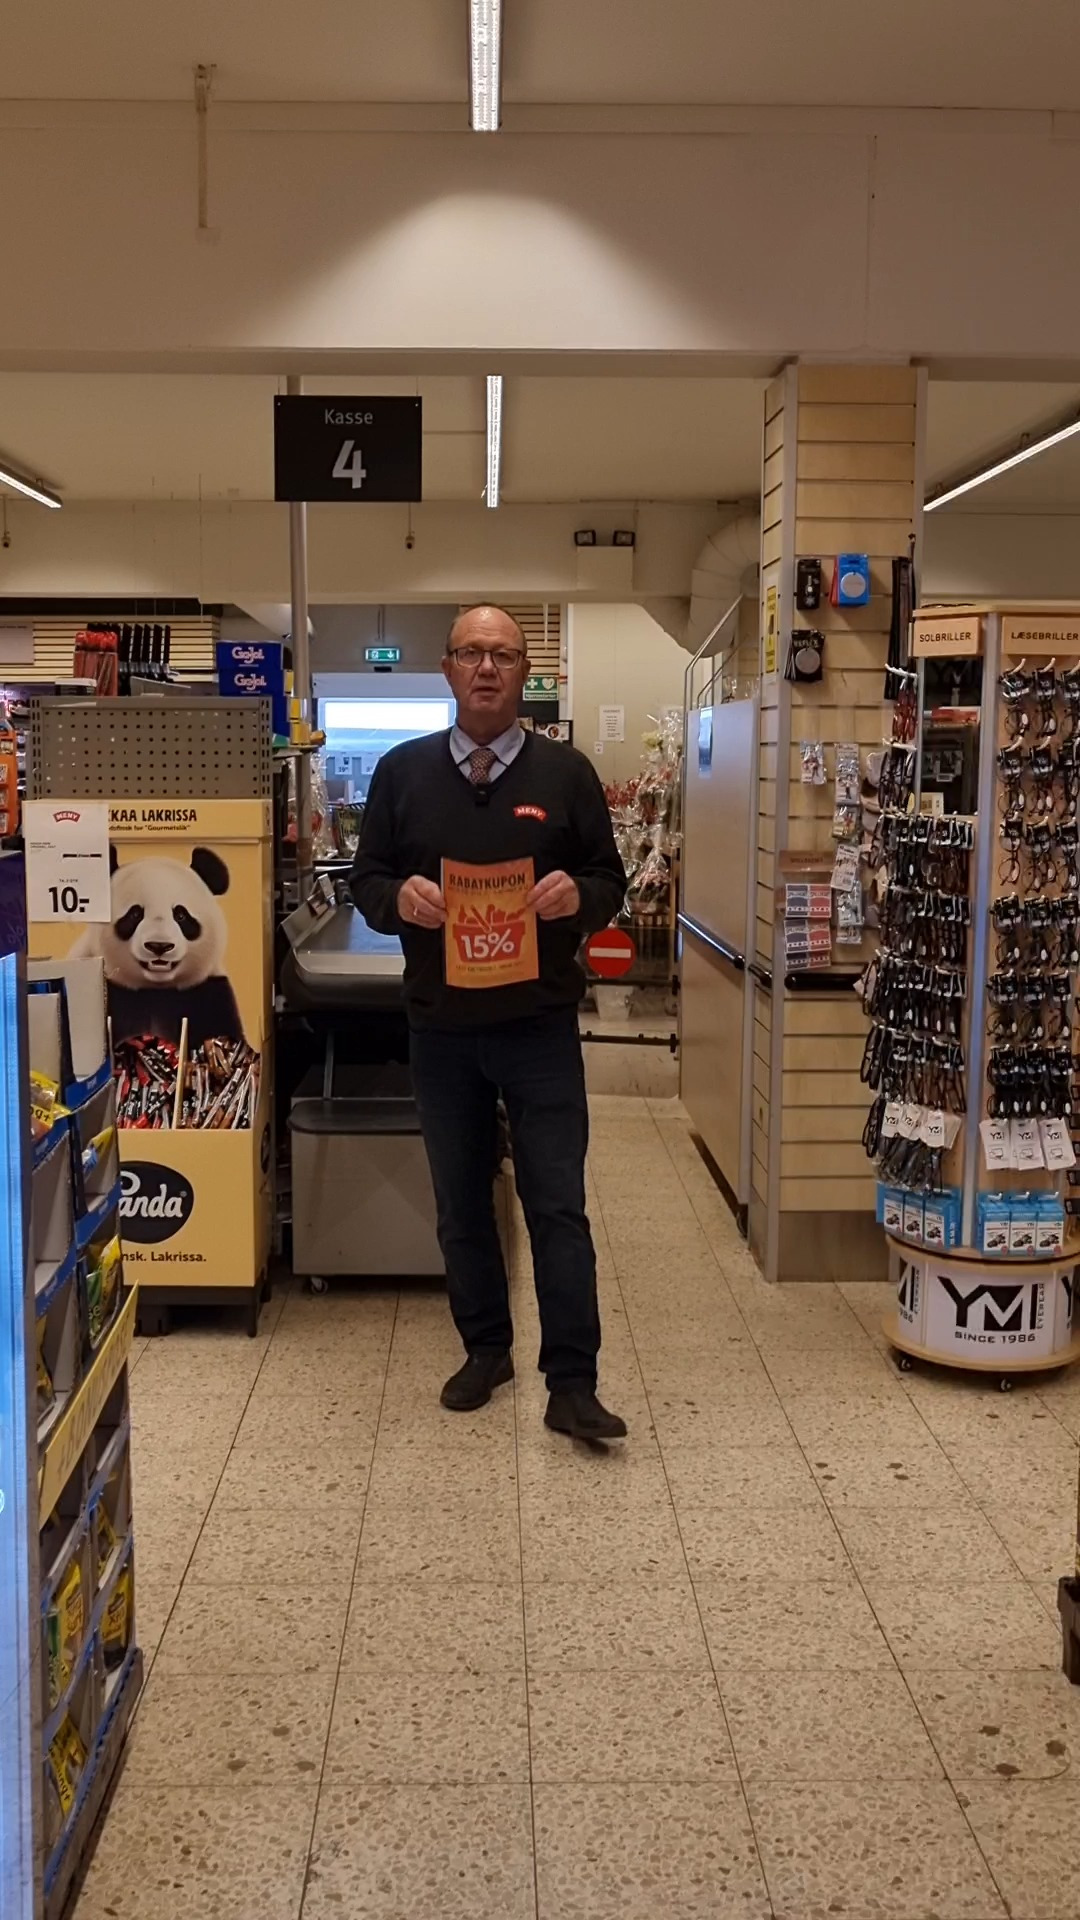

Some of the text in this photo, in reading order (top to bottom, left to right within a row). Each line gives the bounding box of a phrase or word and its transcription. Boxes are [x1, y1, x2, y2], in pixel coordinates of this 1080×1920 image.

[325, 408, 373, 425] Kasse
[332, 440, 366, 489] 4
[919, 631, 971, 642] SOLBRILLER
[1011, 631, 1079, 641] LÆSEBRILLER
[56, 811, 79, 821] MENY
[108, 809, 197, 822] KAA LAKRISSA
[516, 806, 544, 818] MENY
[449, 872, 525, 890] RABATKUPON
[461, 927, 515, 959] 15%
[119, 1171, 184, 1218] Panda
[151, 1251, 207, 1262] Lakrissa.
[937, 1275, 1039, 1332] YMI
[1036, 1282, 1045, 1330] EYEWEAR
[954, 1331, 1036, 1344] SINCE 1986
